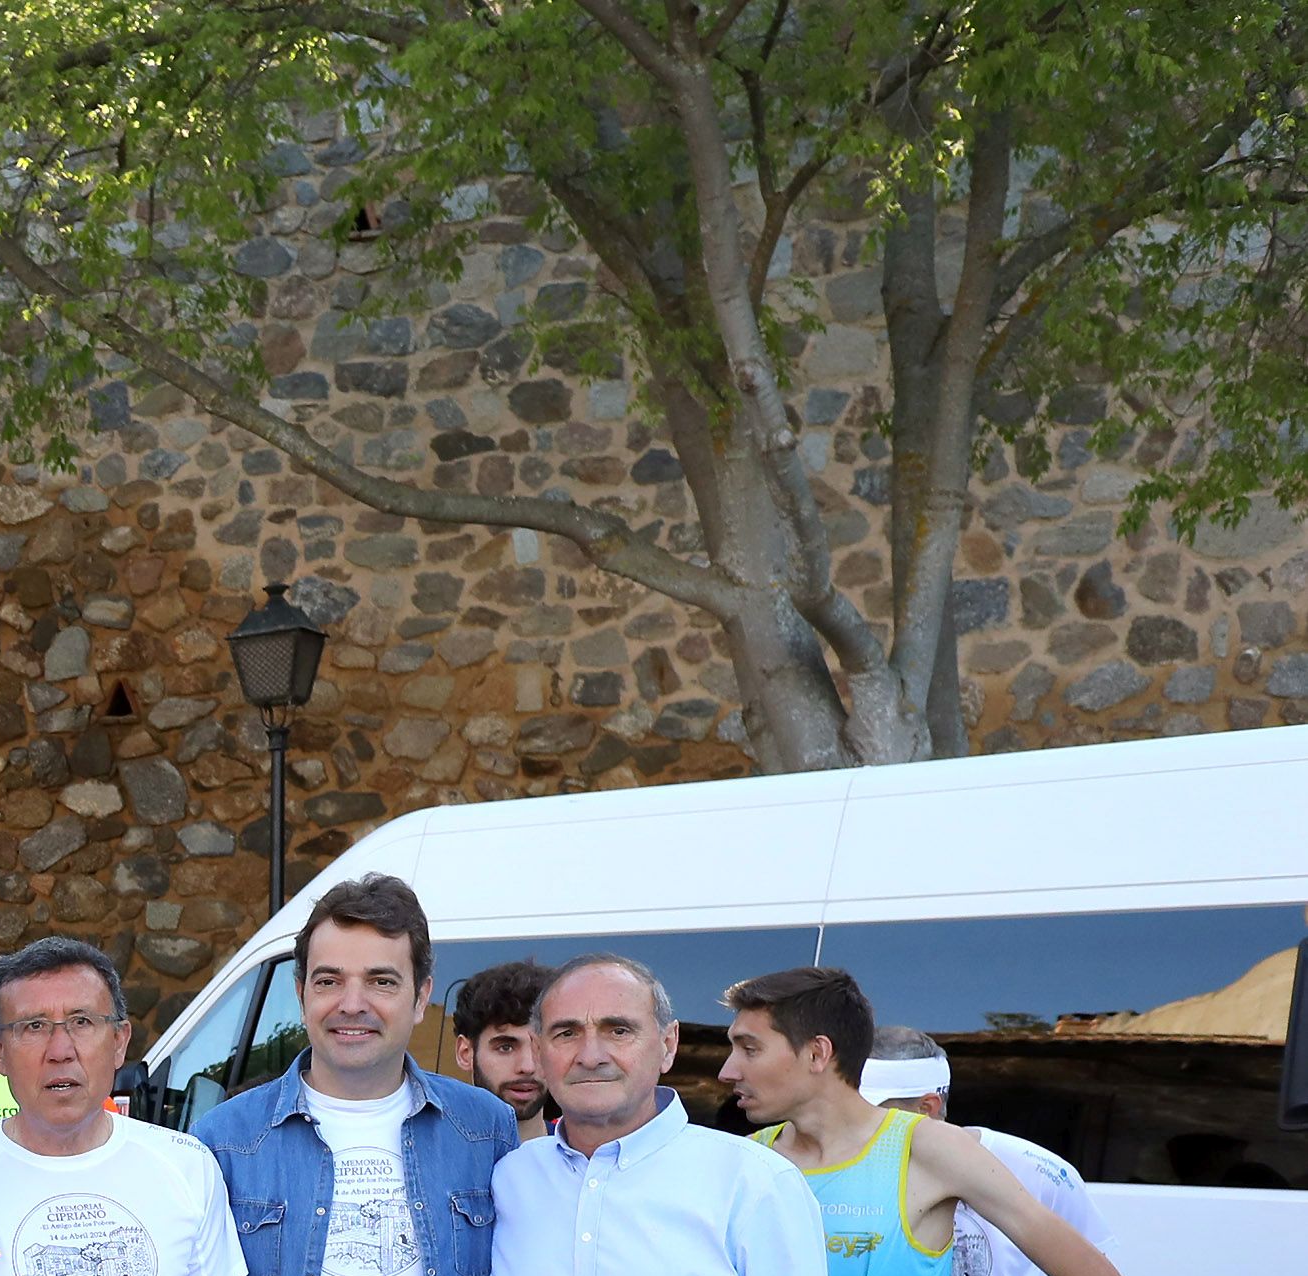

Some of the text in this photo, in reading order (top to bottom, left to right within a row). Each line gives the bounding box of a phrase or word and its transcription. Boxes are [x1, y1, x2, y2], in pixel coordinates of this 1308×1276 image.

[170, 1134, 208, 1154] Toledo
[341, 1159, 392, 1167] MEMORIAL
[334, 1166, 393, 1177] CIPRIANO
[1035, 1163, 1062, 1187] Toledo
[372, 1187, 390, 1195] 2024
[55, 1203, 104, 1213] MEMORIAL
[46, 1210, 107, 1222] CIPRIANO
[69, 1232, 89, 1240] Abril
[89, 1231, 107, 1239] 2024
